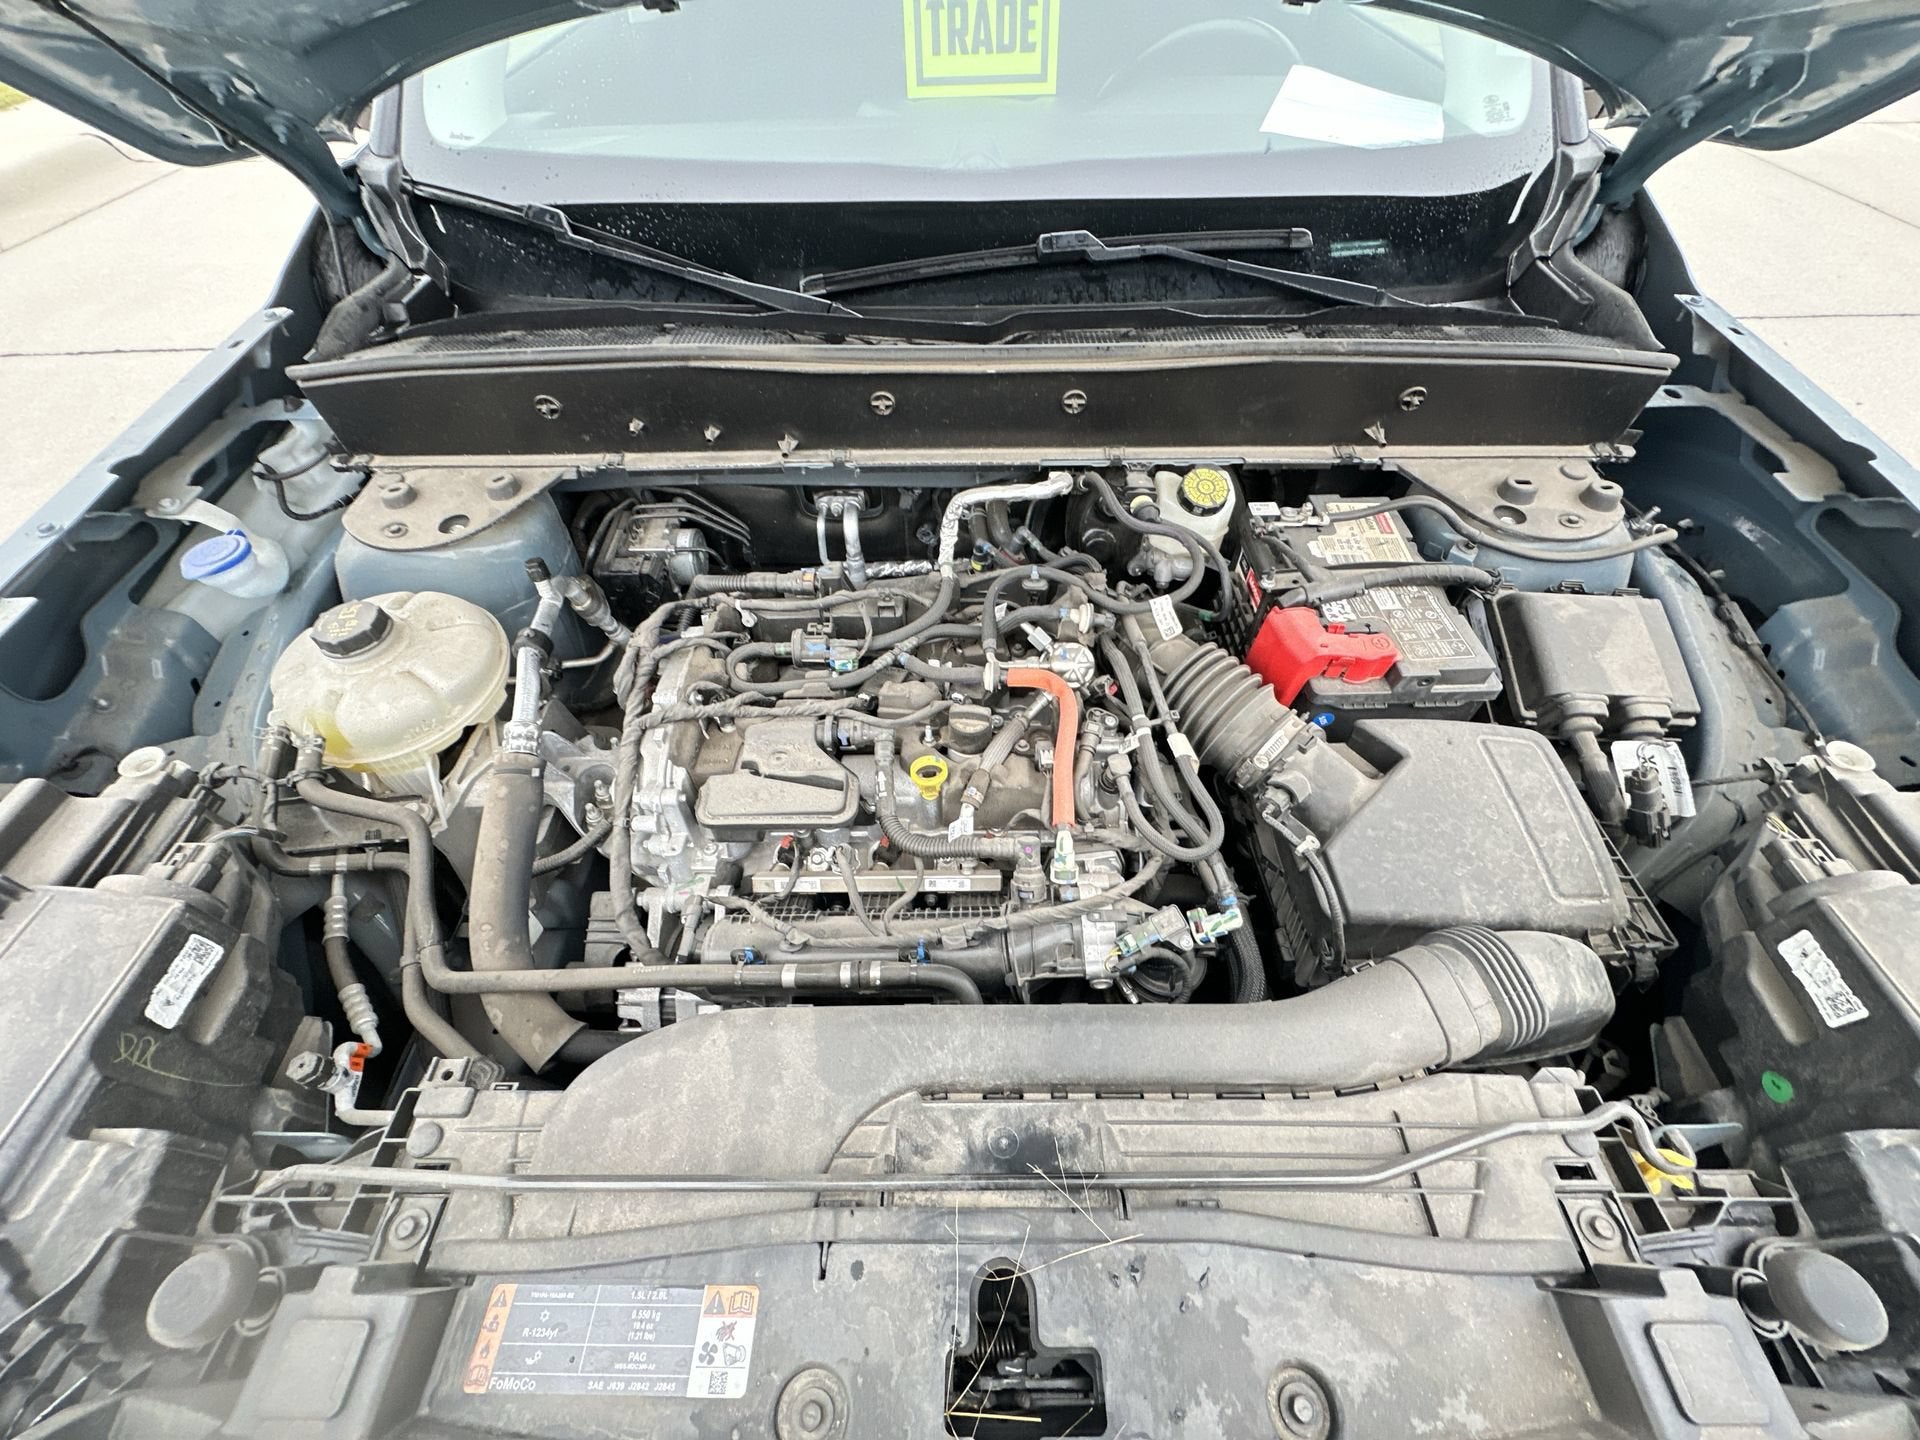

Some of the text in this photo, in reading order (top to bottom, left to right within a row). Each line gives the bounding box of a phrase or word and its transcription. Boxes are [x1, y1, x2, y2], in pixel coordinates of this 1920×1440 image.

[925, 0, 1039, 56] TRADE
[631, 1309, 662, 1321] 0.550 kg
[522, 1327, 560, 1340] R-1234yf
[627, 1351, 648, 1362] PAG
[488, 1376, 537, 1391] FoMoCo
[586, 1380, 605, 1391] SAE
